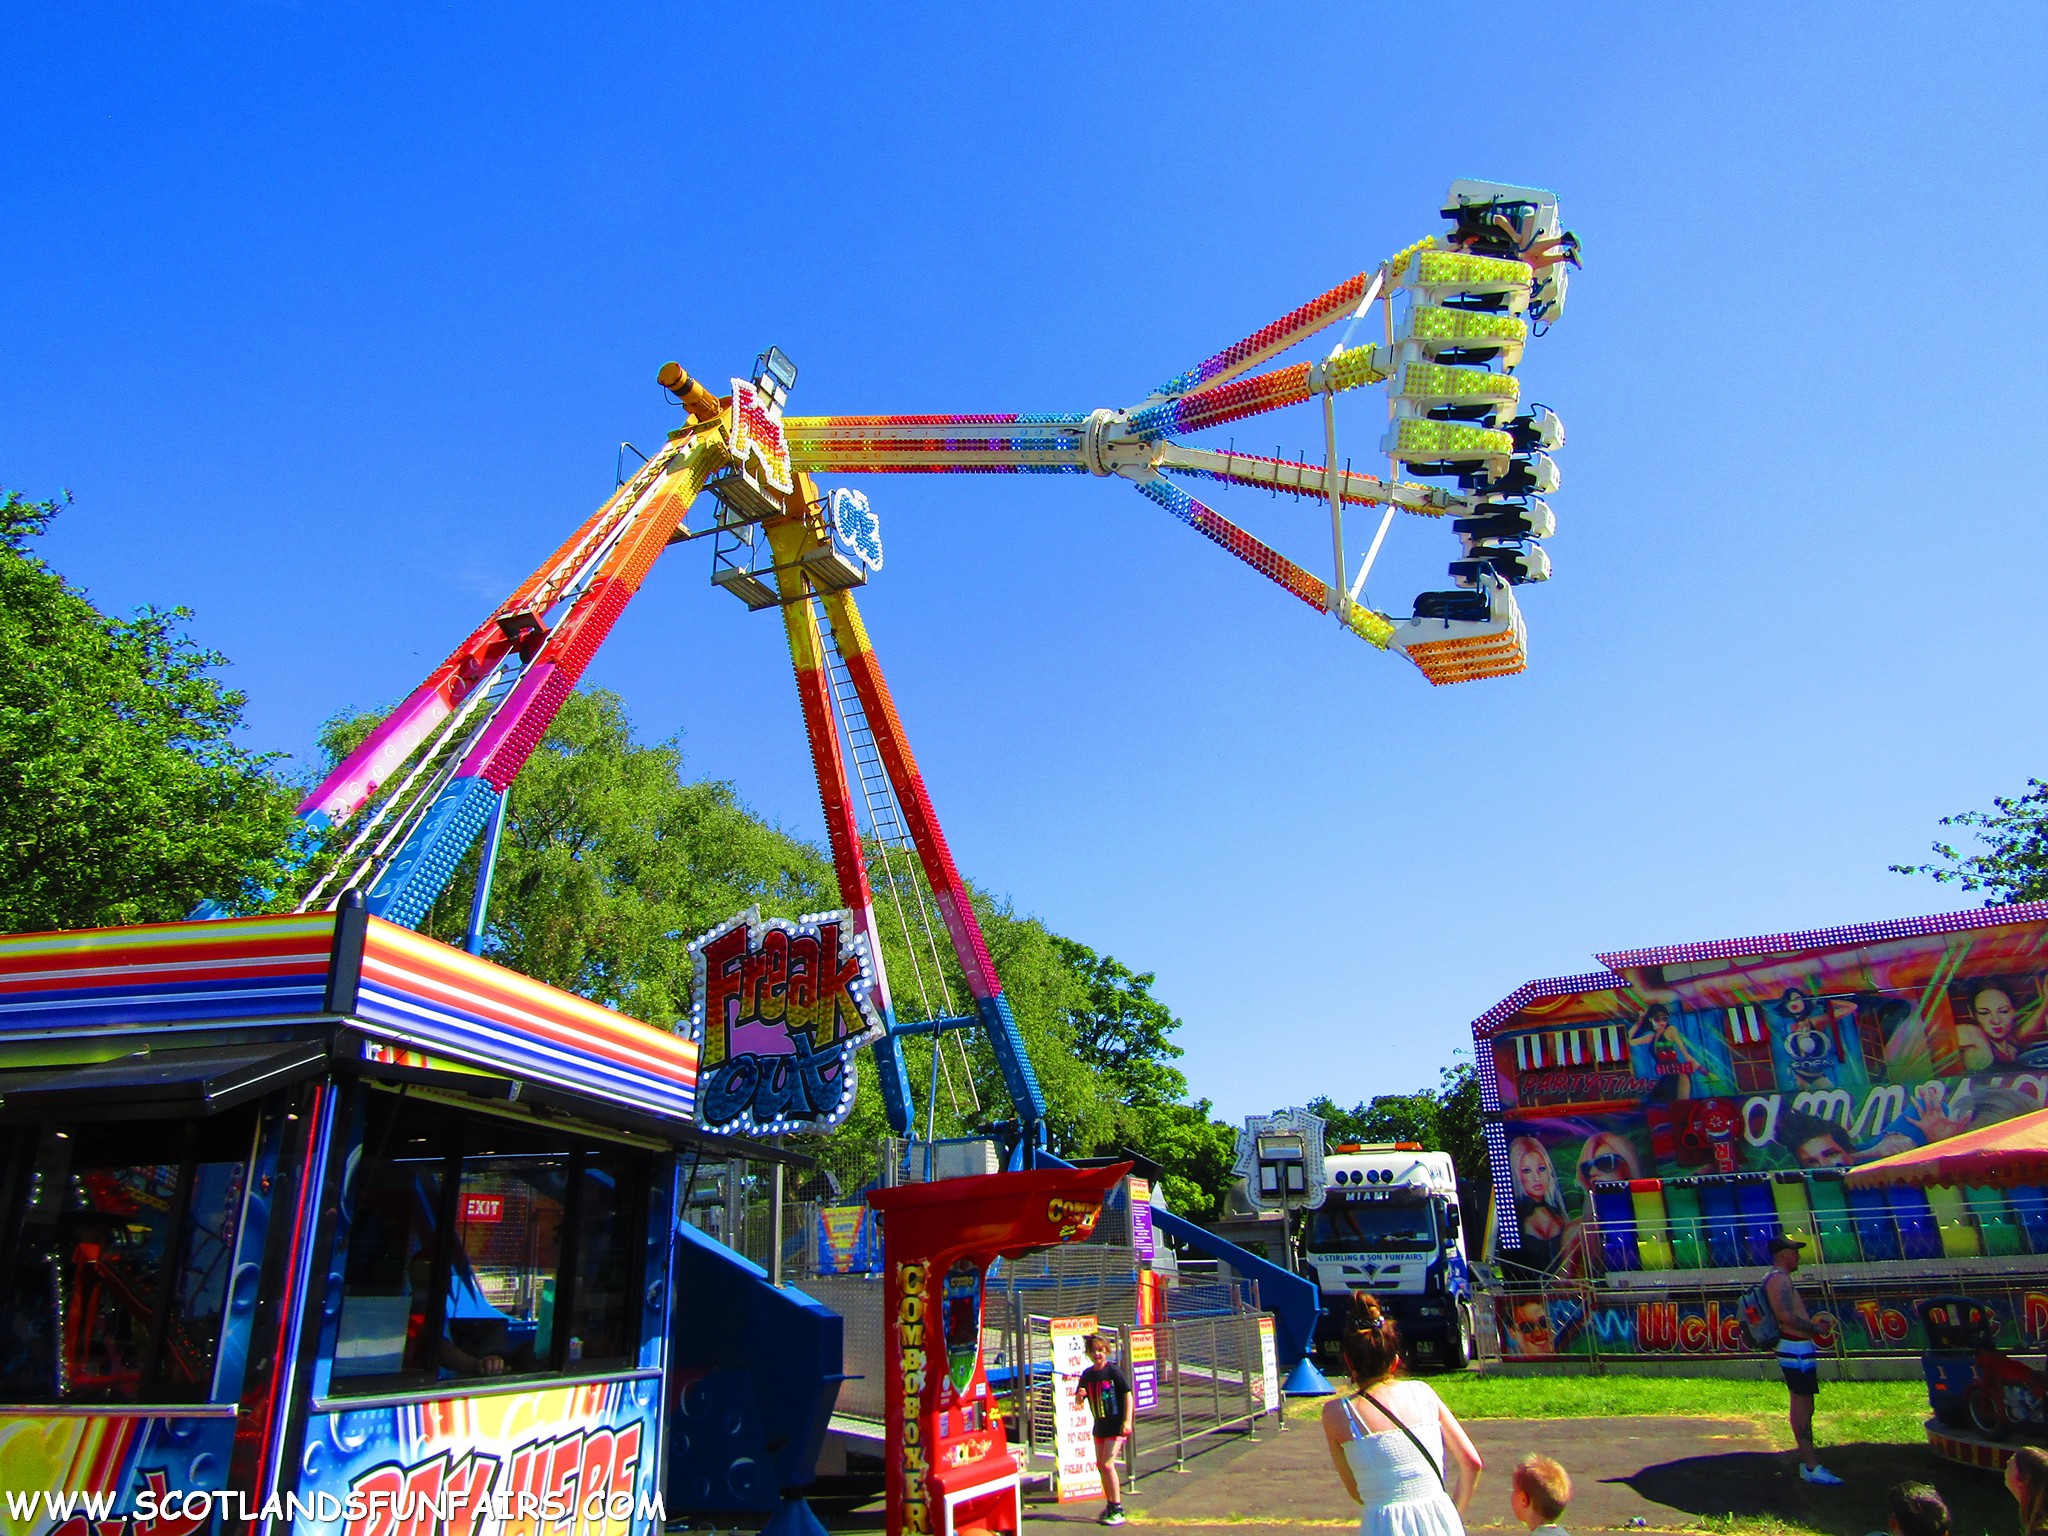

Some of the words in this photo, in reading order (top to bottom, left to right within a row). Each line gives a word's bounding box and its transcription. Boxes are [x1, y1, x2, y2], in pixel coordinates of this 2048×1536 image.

[702, 924, 866, 1067] Freak
[704, 1033, 843, 1121] out
[1521, 1071, 1599, 1095] PARTY
[1601, 1075, 1660, 1094] TIME
[1345, 1191, 1390, 1201] MIAMI
[467, 1199, 500, 1216] EXIT
[1385, 1253, 1423, 1261] FUNFAIRS
[1855, 1300, 1908, 1341] To
[1068, 1355, 1081, 1367] YOU
[1067, 1432, 1076, 1444] TO
[1077, 1431, 1091, 1442] RIDE
[1074, 1447, 1086, 1458] THE
[1064, 1463, 1084, 1475] FREAK
[498, 1422, 643, 1536] HERE
